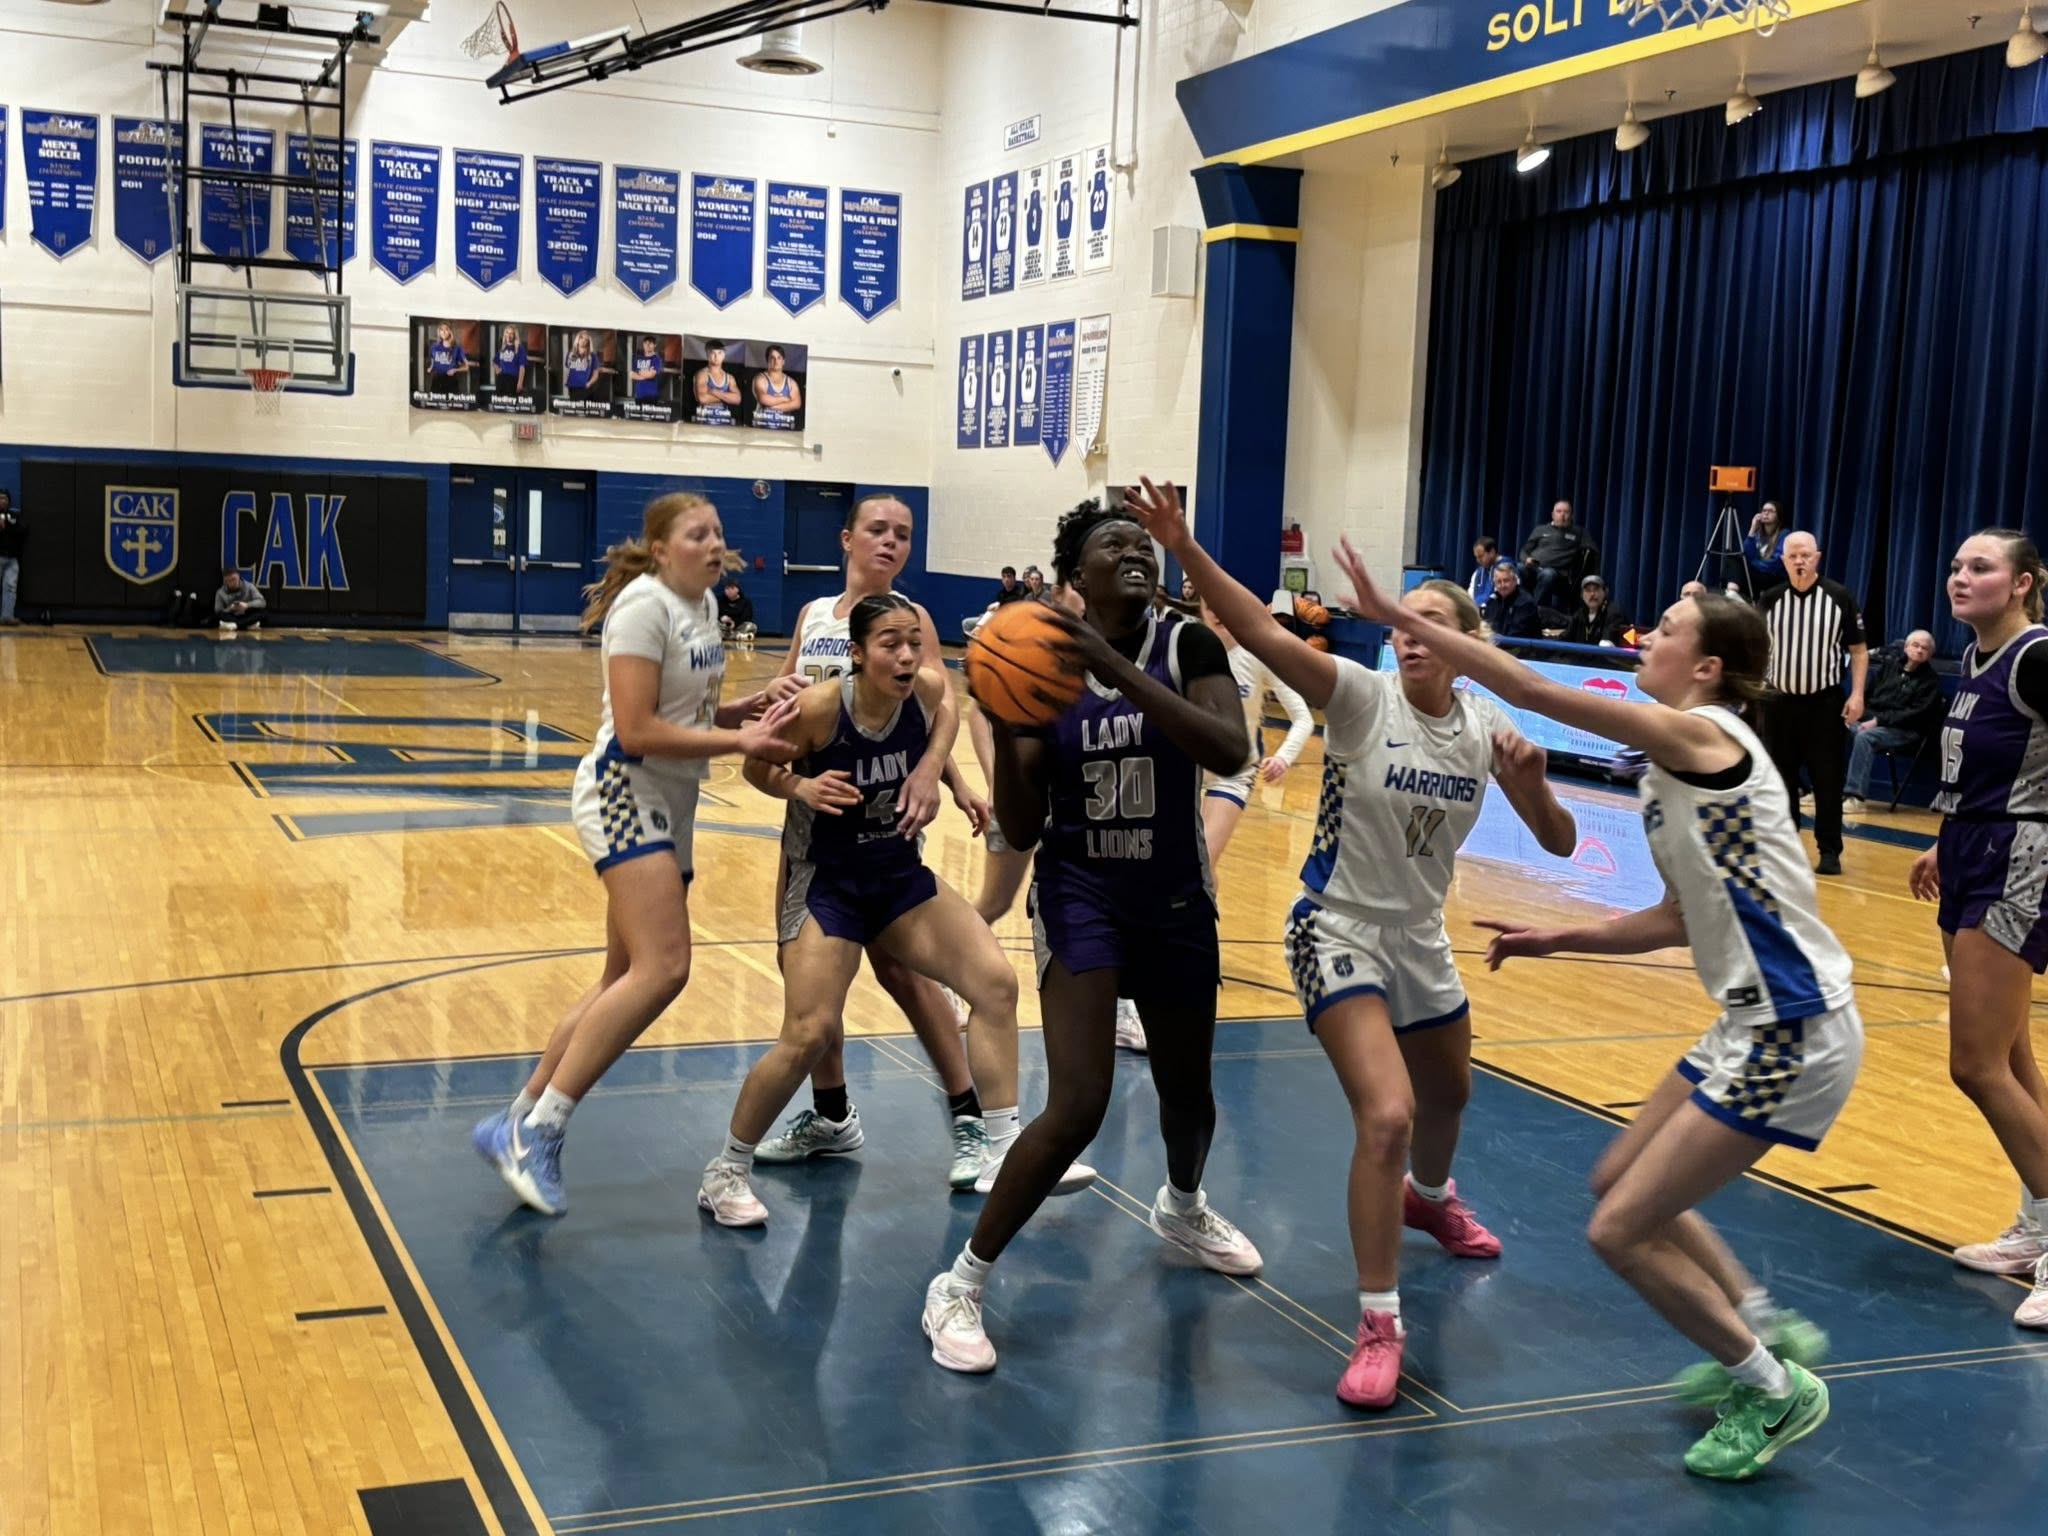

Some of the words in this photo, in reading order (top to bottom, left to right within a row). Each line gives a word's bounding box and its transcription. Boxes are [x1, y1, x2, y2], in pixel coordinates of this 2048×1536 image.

[42, 139, 78, 151] MEN'S
[39, 148, 81, 160] SOCCER
[305, 161, 340, 172] FELD
[379, 159, 419, 171] TRACK
[423, 163, 432, 173] &
[388, 168, 422, 180] FIELD
[462, 167, 500, 179] TRACK
[504, 172, 514, 181] &
[471, 177, 504, 188] FIELD
[542, 174, 580, 186] TRACK
[584, 178, 594, 188] &
[552, 184, 585, 195] FIELD
[723, 183, 746, 193] CAK
[788, 190, 809, 199] CAK
[455, 198, 484, 208] HIGH
[487, 201, 521, 212] JUMP
[624, 193, 669, 204] WOMEN'S
[861, 197, 881, 206] CAK
[1093, 191, 1105, 212] 23
[547, 207, 588, 219] 1600m
[617, 201, 643, 211] TRACK
[645, 203, 652, 213] &
[653, 205, 676, 215] FIELD
[697, 201, 749, 214] WOMEN'S
[769, 206, 794, 217] TRACK
[796, 208, 802, 218] &
[804, 210, 825, 220] FIELD
[843, 213, 867, 223] TRACK
[869, 215, 875, 224] &
[877, 216, 897, 226] FIELD
[471, 222, 503, 233] 100m
[469, 243, 504, 255] 200m
[546, 240, 589, 252] 3200m
[113, 494, 171, 518] CAK
[220, 490, 350, 590] CAK
[1082, 712, 1144, 752] LADY
[1941, 726, 1965, 784] 15
[856, 750, 908, 787] LADY
[1082, 756, 1155, 821] 30
[1384, 763, 1477, 803] WARRIORS
[1086, 828, 1153, 860] LIONS
